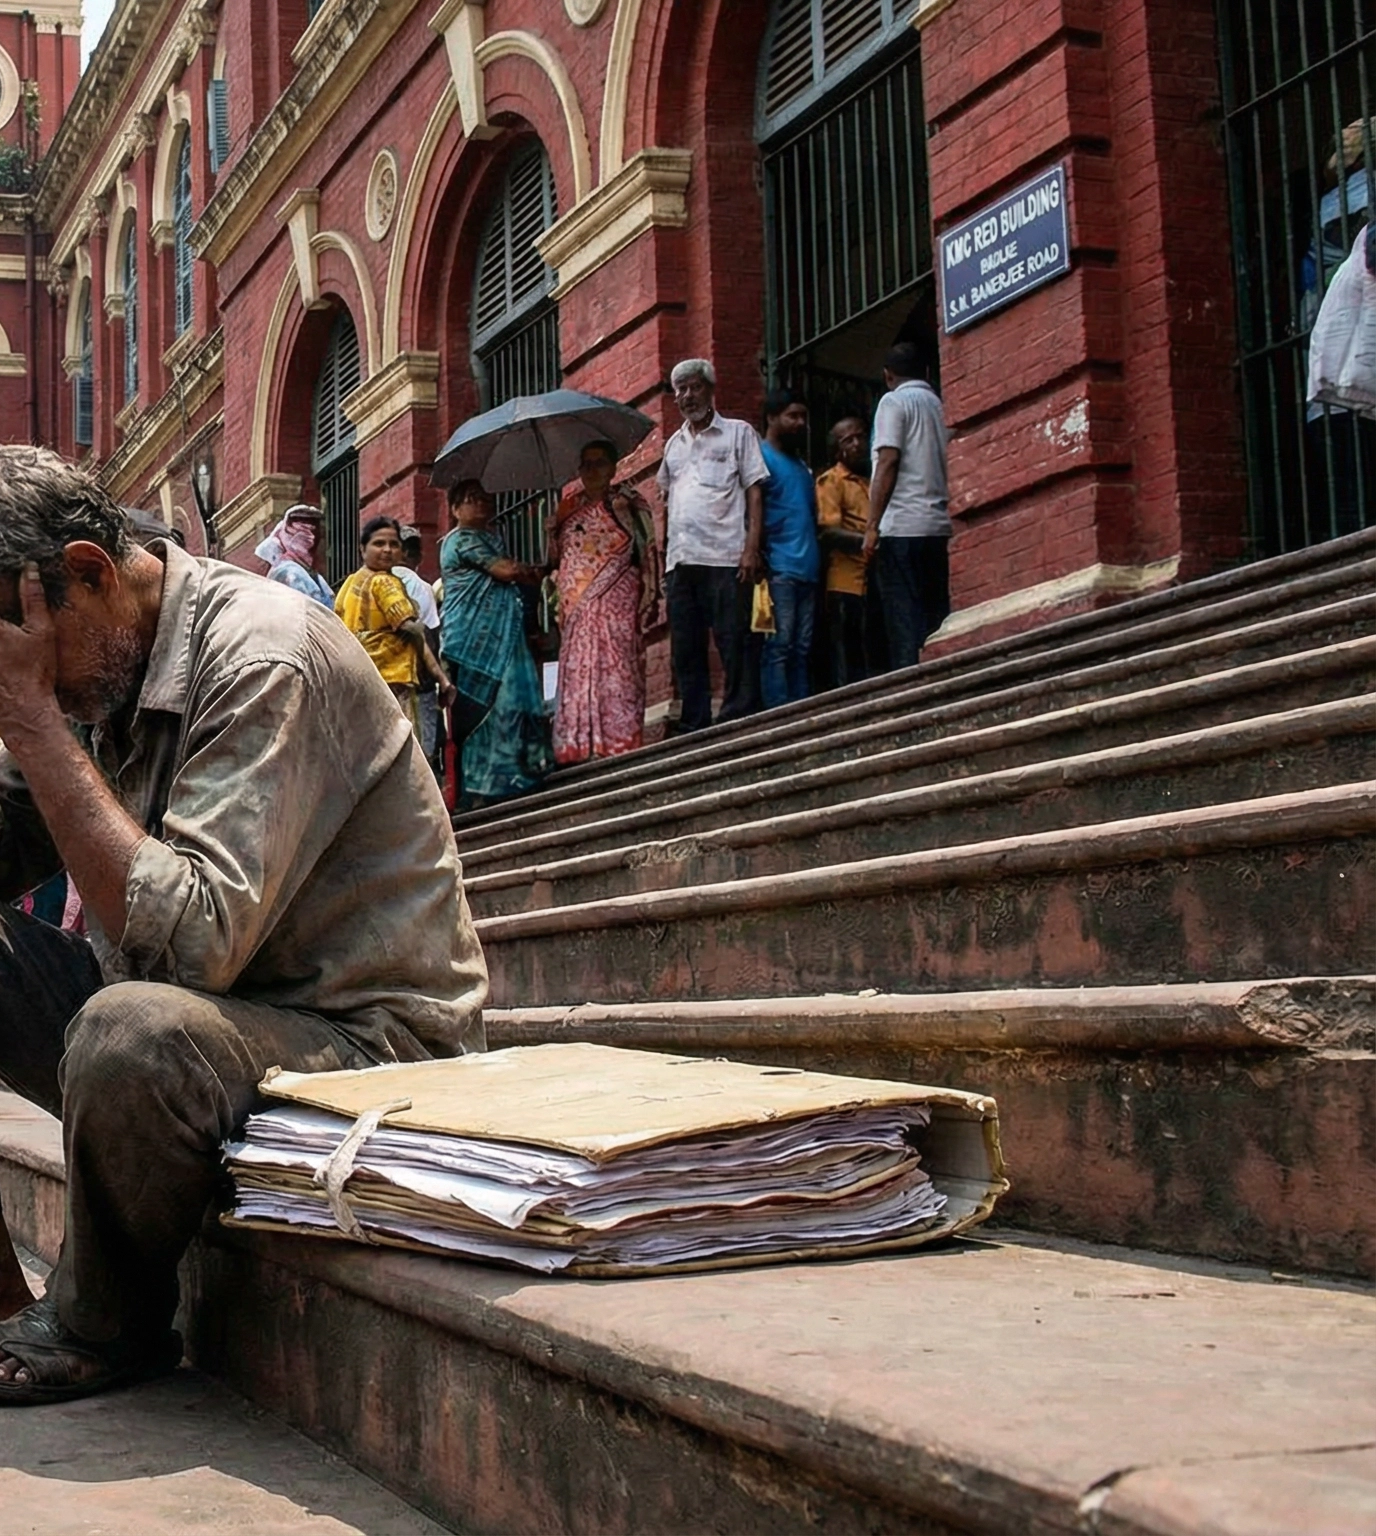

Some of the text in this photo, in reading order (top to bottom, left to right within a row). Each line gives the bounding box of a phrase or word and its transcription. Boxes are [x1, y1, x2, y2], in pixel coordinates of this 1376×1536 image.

[946, 179, 1059, 269] KMC RED BUILDING
[971, 260, 1025, 306] BANERJEE
[1027, 243, 1059, 275] ROAD
